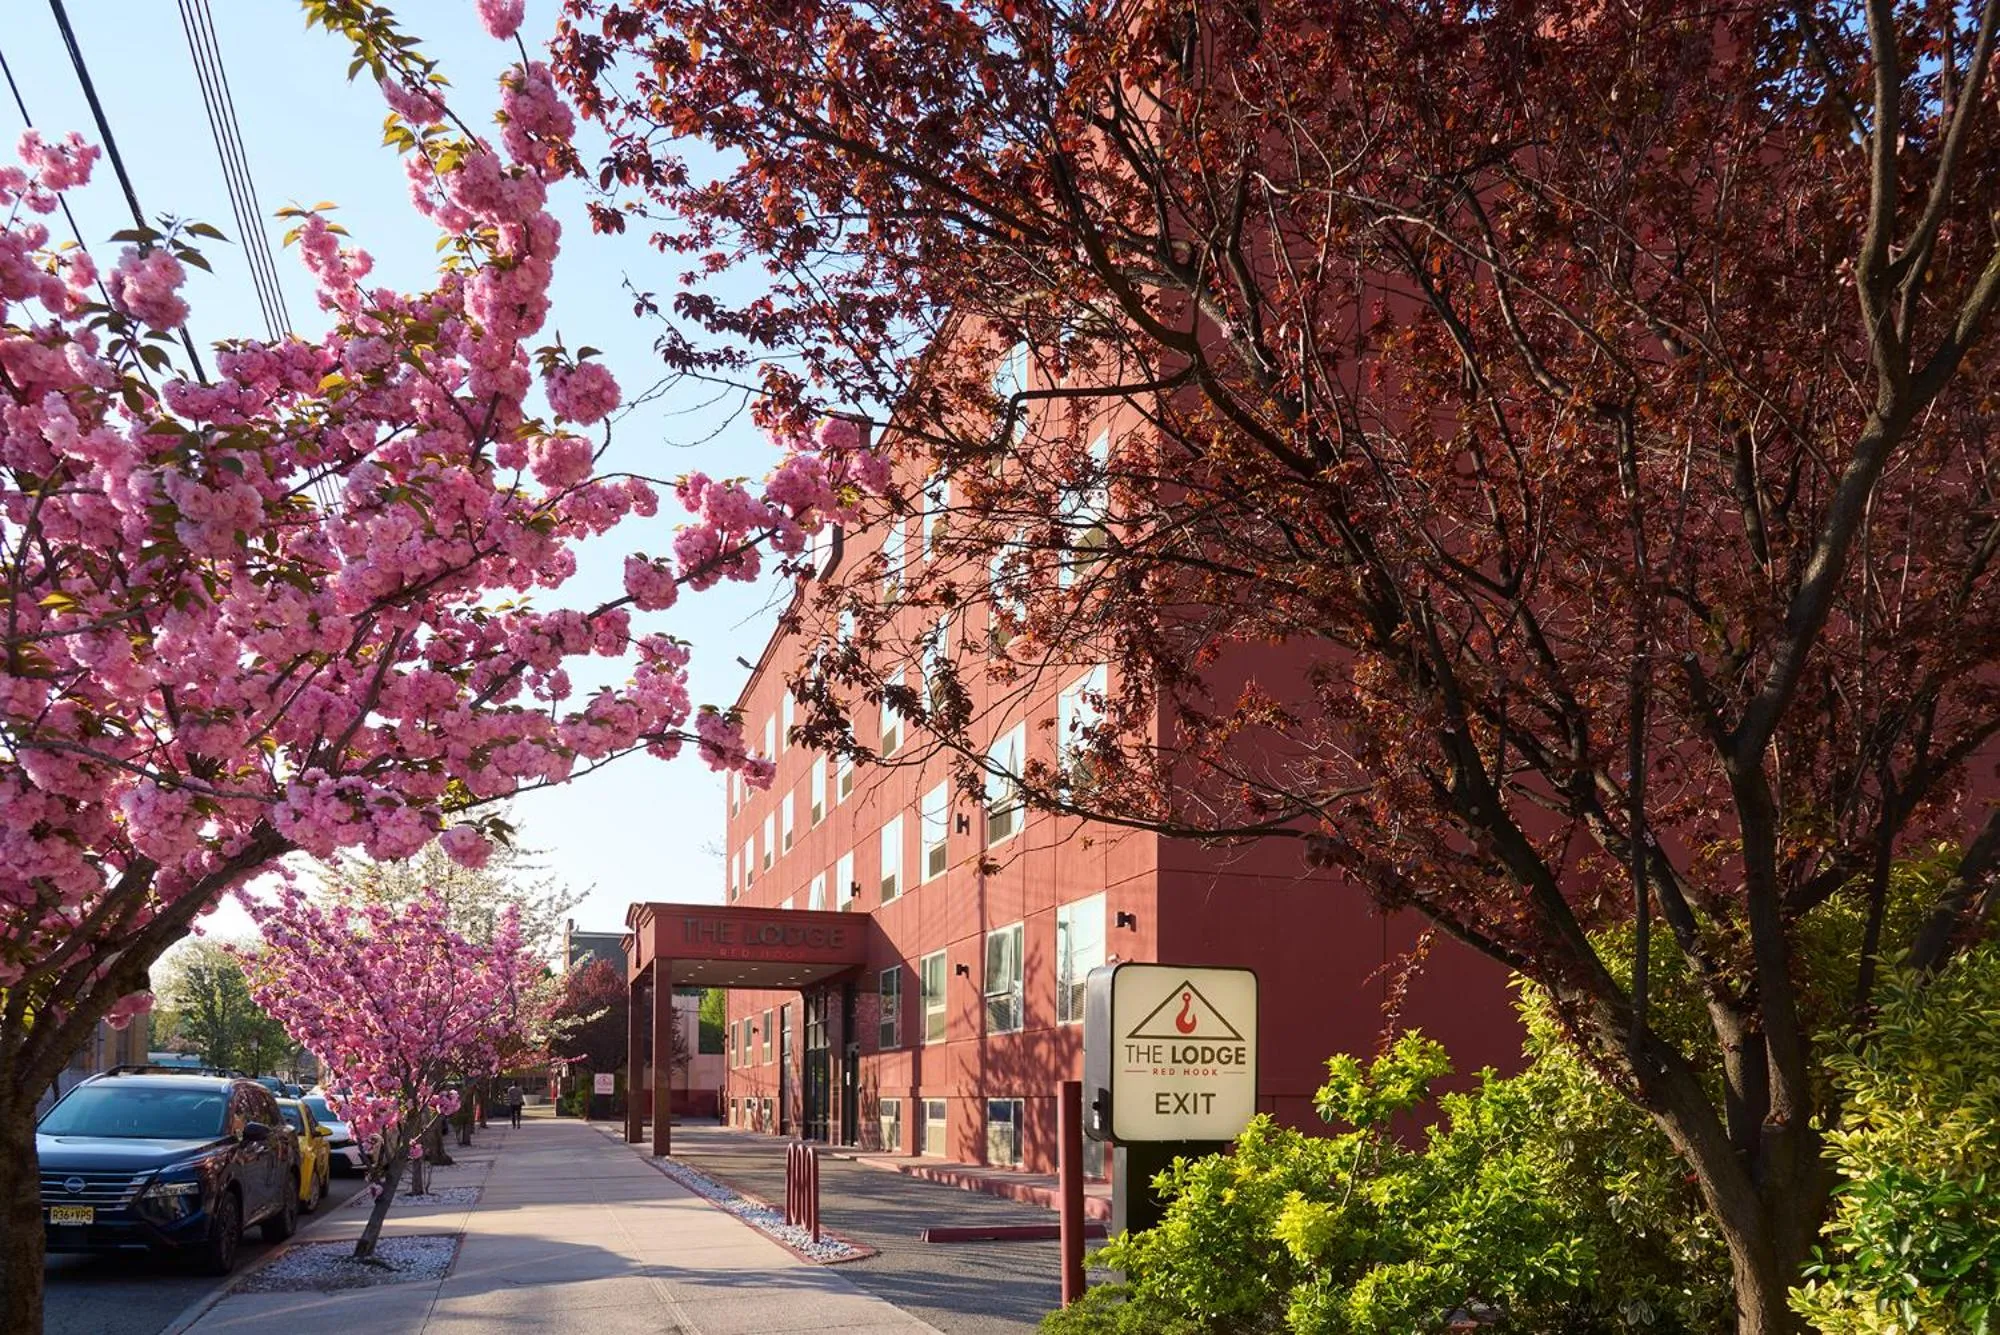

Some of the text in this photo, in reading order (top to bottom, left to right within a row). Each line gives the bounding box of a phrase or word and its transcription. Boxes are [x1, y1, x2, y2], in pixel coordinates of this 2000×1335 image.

[684, 918, 845, 948] THE LODGE
[1124, 1044, 1246, 1065] THE LODGE
[1152, 1067, 1218, 1077] RED HOOK
[1155, 1092, 1216, 1115] EXIT
